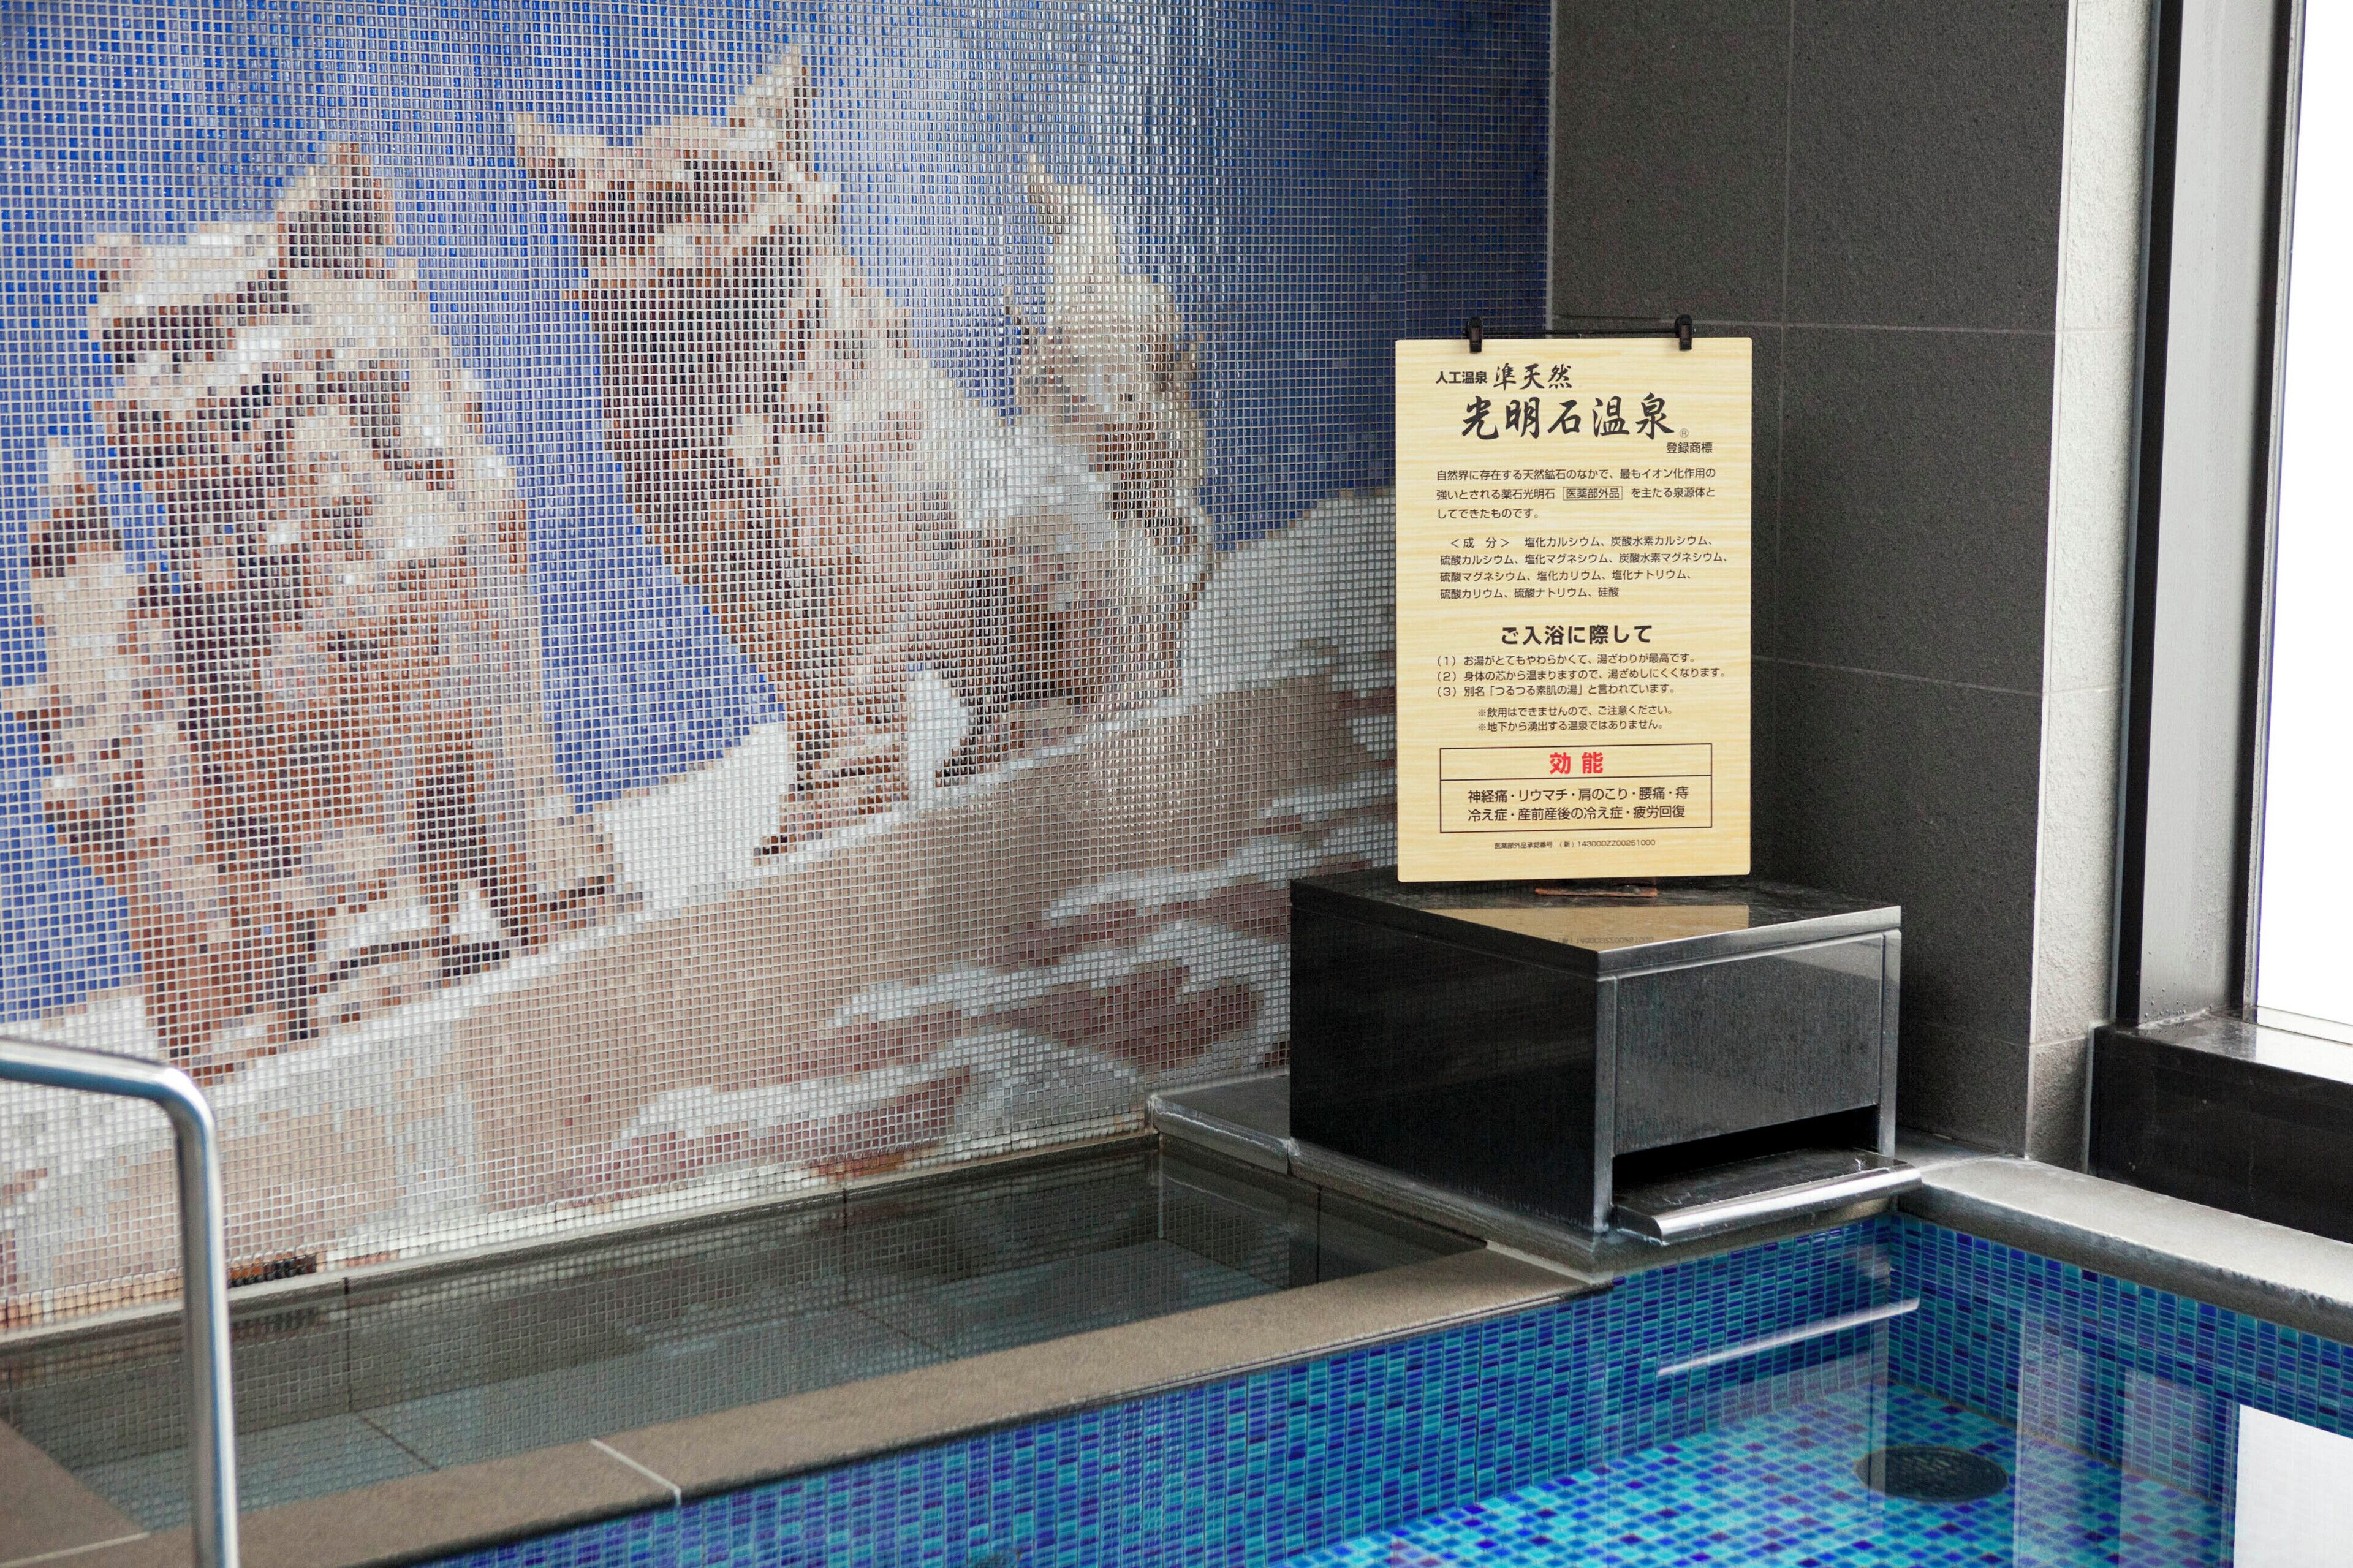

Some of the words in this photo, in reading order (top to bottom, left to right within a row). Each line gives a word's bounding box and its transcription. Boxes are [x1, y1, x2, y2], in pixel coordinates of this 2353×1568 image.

[1435, 370, 1488, 384] 人工温泉
[1493, 362, 1572, 391] 準天然
[1461, 392, 1675, 441] 光明石温泉
[1665, 441, 1713, 454] 登録商標
[1436, 468, 1716, 481] 自然界に存在する天然鉱石のなかで、最もイオン化作用の
[1436, 488, 1555, 501] 強いとされる薬石光明石
[1566, 488, 1620, 499] 医薬部外品
[1631, 487, 1716, 498] を主たる泉源体と
[1437, 507, 1539, 520] してできたものです。
[1501, 624, 1653, 646] ご入浴に際して
[1467, 805, 1686, 822] 冷え症・産前産後の冷え症・疲労回復
